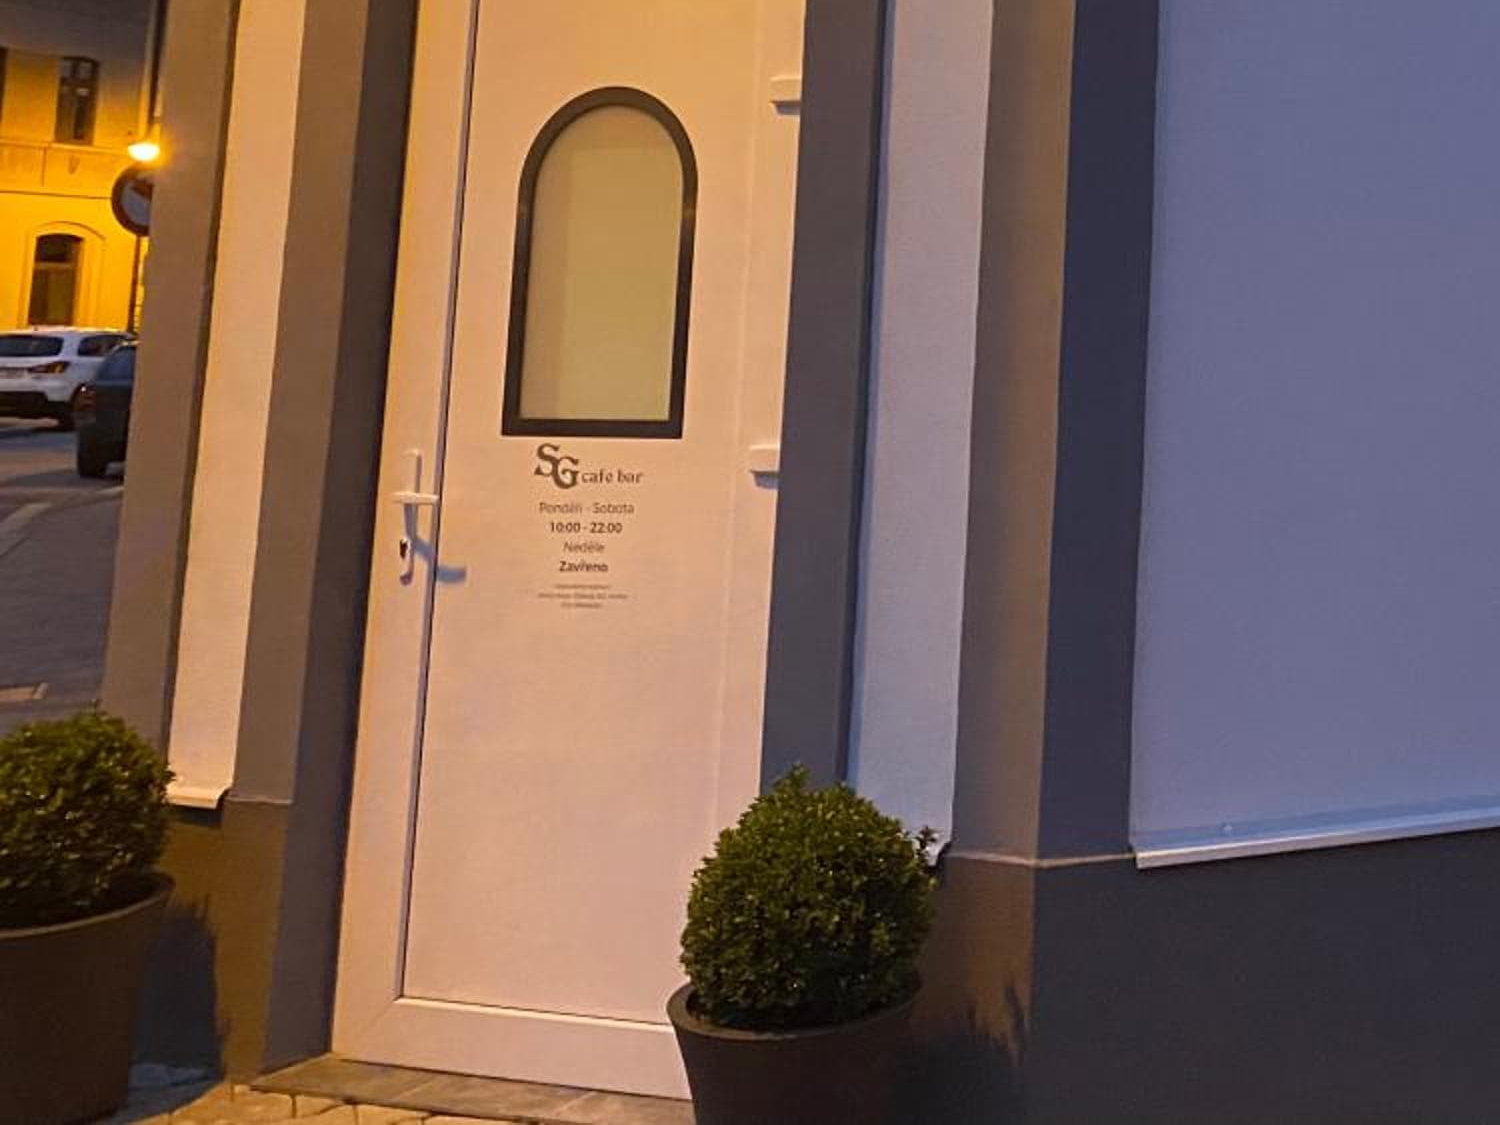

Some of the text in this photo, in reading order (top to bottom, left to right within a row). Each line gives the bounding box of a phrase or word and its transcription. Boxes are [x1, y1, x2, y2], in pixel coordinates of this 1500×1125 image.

[533, 442, 645, 490] SG cafe bar
[592, 501, 635, 515] Sobota
[550, 521, 582, 534] 10:00
[589, 521, 623, 535] 22:00
[559, 559, 609, 573] Zavřeno
